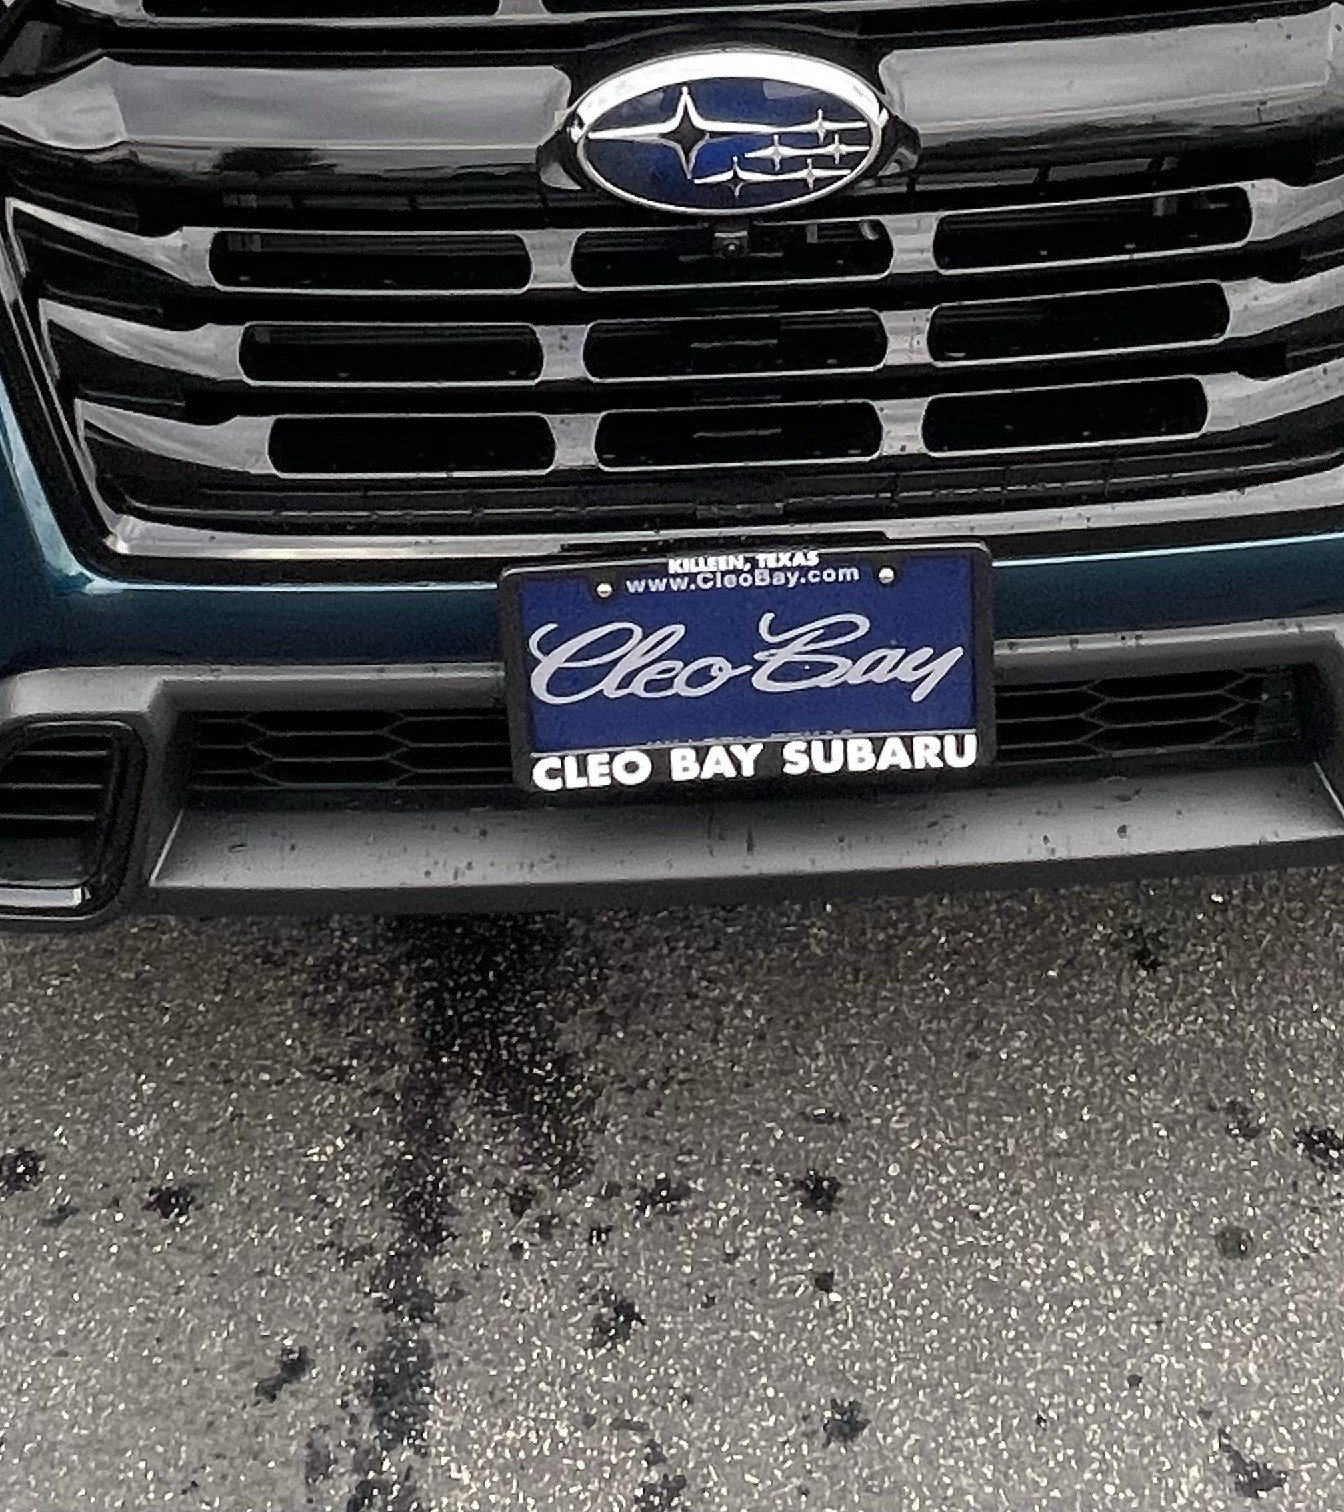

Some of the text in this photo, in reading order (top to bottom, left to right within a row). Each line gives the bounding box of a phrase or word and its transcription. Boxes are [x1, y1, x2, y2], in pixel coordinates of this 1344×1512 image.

[626, 566, 860, 594] www.CleoBay.com
[667, 550, 820, 574] KILLEEN, TEXAS
[528, 611, 964, 705] Cleo Bay
[531, 734, 978, 791] CLEO BAY SUBARU
